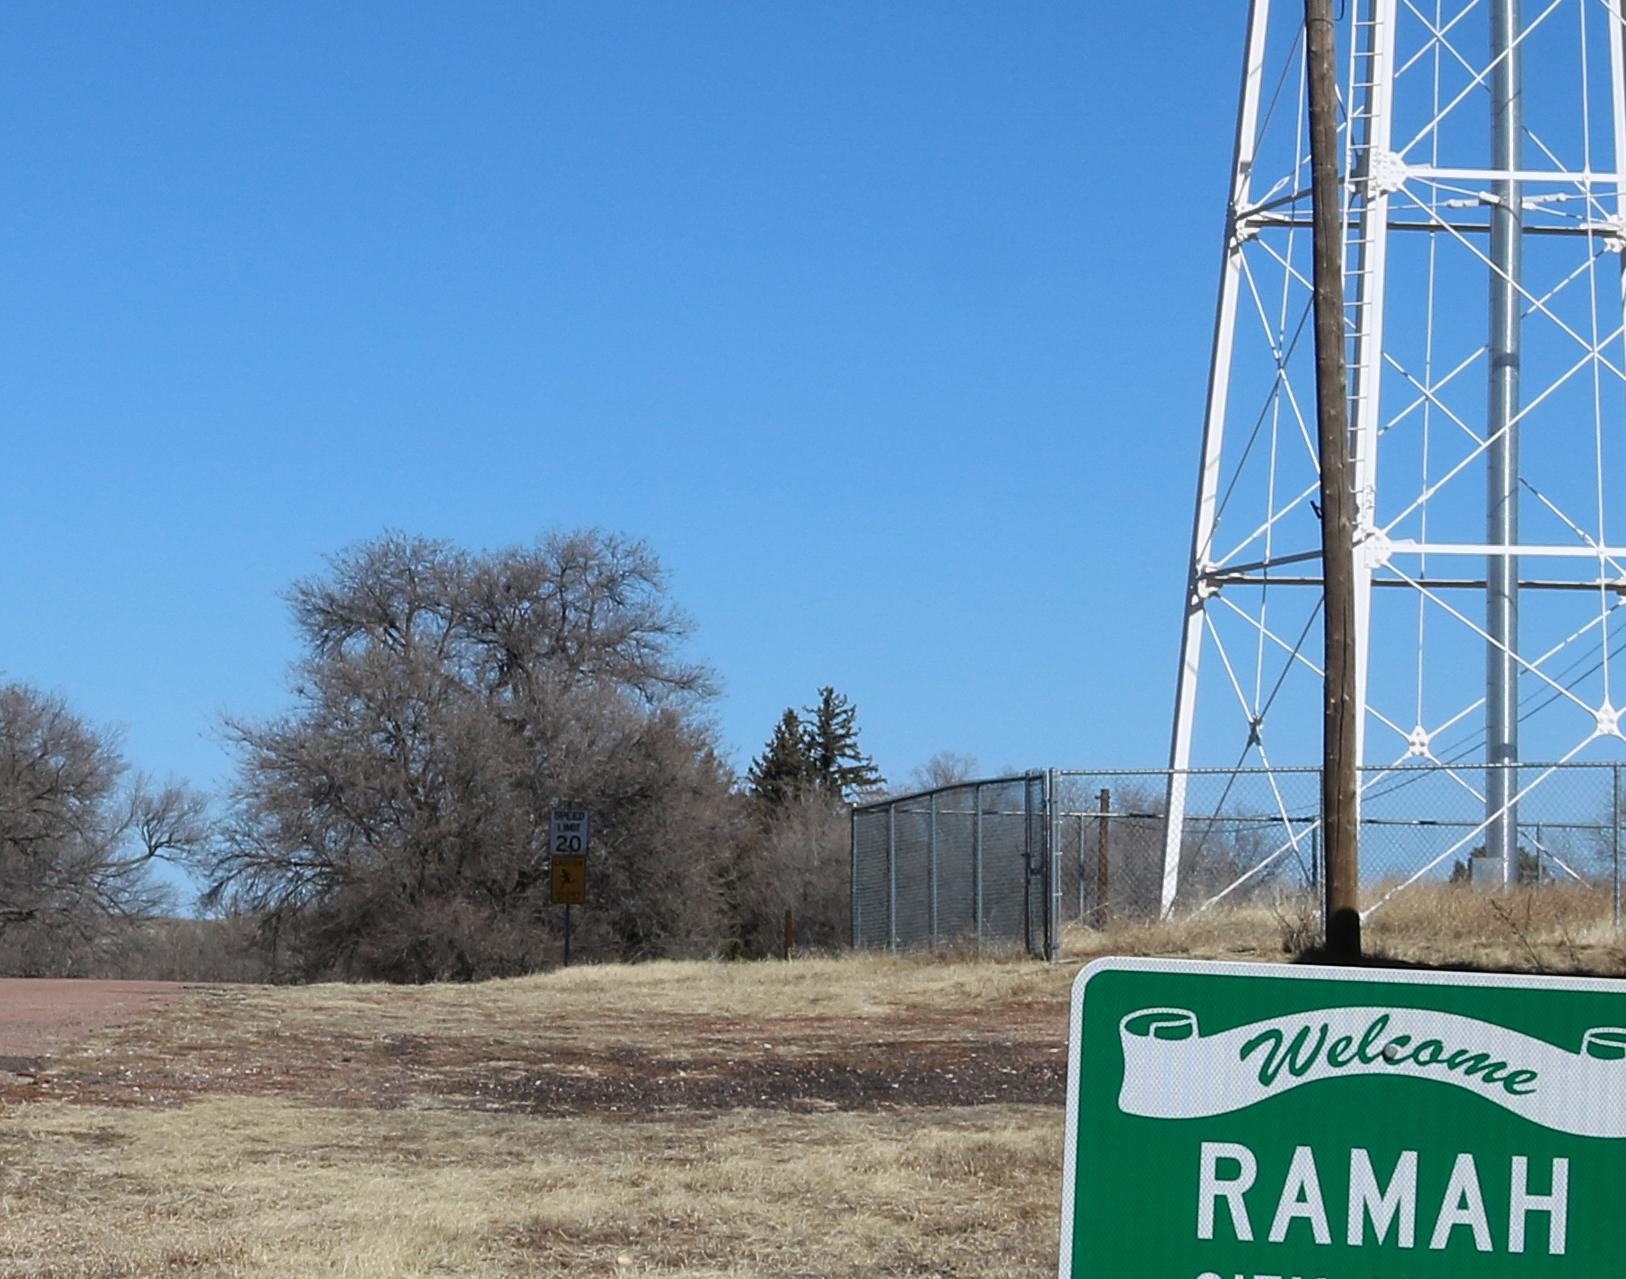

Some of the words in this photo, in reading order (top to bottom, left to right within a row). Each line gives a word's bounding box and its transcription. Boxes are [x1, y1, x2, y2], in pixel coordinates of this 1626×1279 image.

[554, 811, 585, 821] SPEED
[558, 823, 581, 832] LIMIT
[556, 835, 582, 852] 20
[1239, 1013, 1538, 1096] Welcome
[1196, 1141, 1570, 1255] RAMAH
